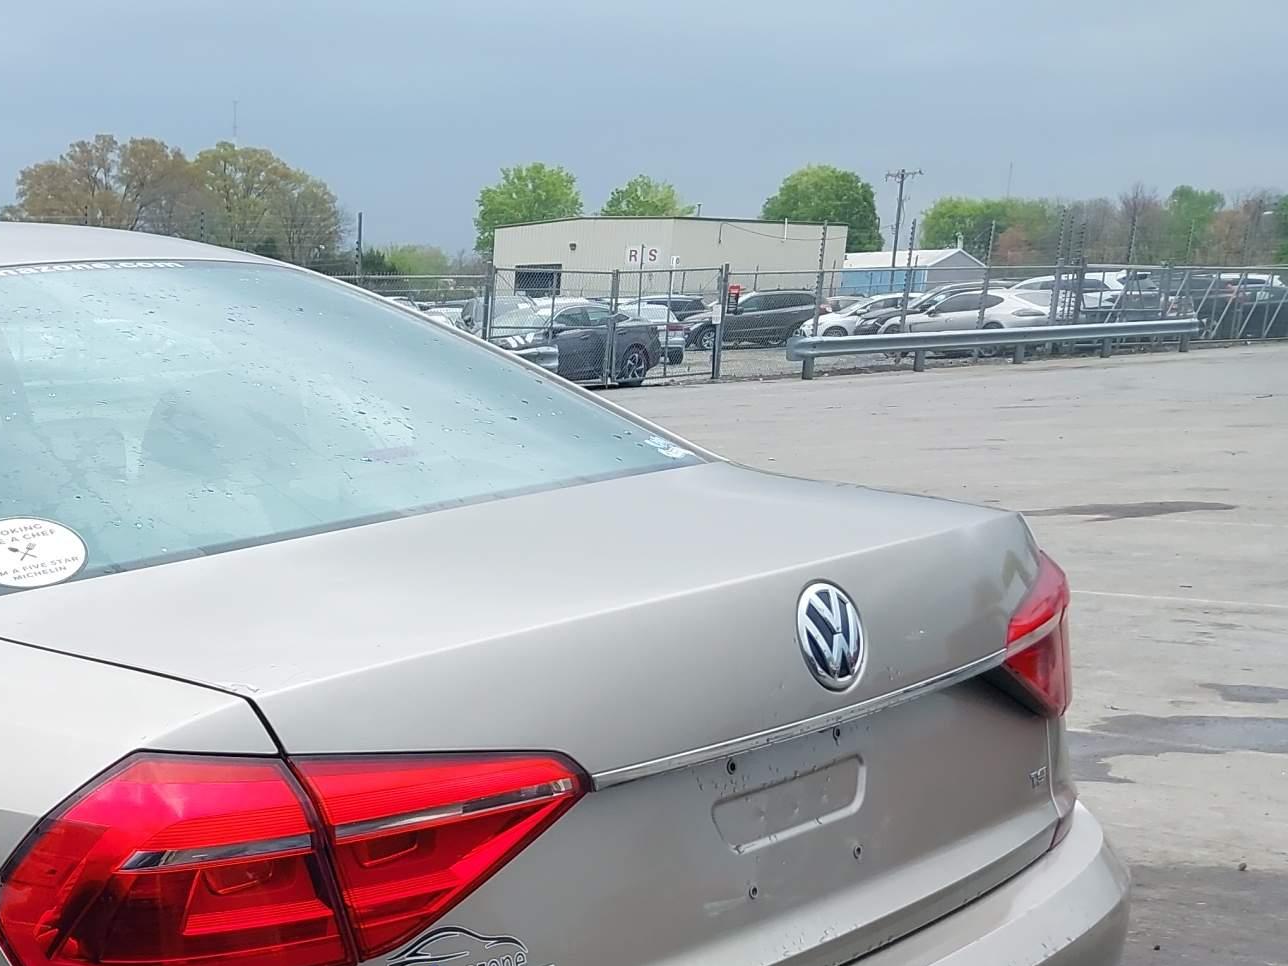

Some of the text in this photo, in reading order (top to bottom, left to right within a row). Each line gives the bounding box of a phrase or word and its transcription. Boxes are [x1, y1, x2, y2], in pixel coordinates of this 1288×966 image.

[629, 249, 658, 262] R S
[22, 528, 57, 540] CHEF
[23, 562, 48, 572] FIVE
[50, 556, 79, 566] STAR
[13, 565, 67, 581] MICHELIN
